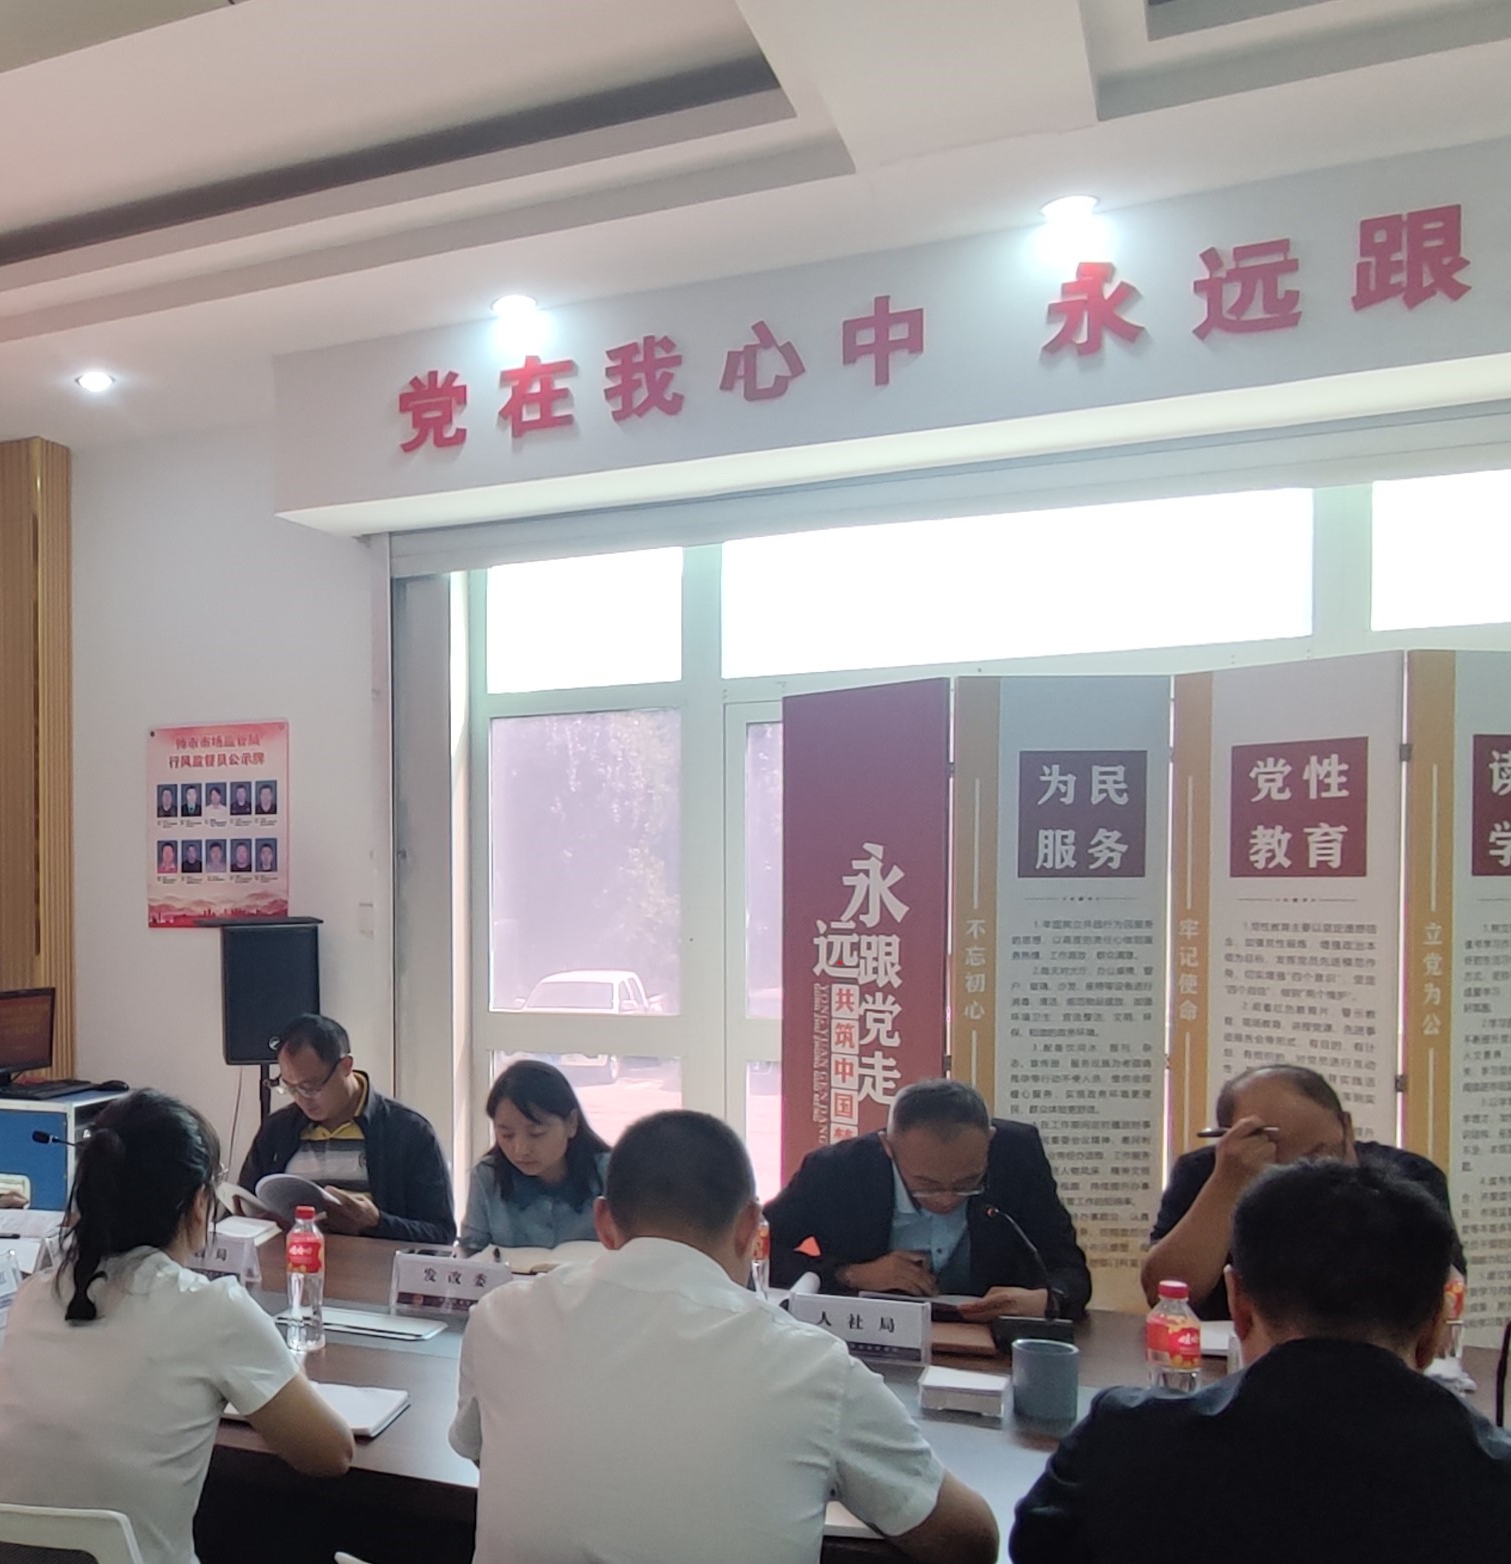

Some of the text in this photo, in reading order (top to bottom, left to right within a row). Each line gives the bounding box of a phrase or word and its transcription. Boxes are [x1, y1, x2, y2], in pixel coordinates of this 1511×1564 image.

[398, 203, 1472, 453] 党在我心中 永远跟
[1037, 764, 1130, 806] 为民
[1249, 753, 1350, 803] 党性
[1035, 828, 1130, 870] 服务
[1249, 822, 1350, 870] 教育
[964, 918, 986, 1021] 不忘初心
[1178, 917, 1200, 1022] 牢记使命
[1421, 921, 1444, 1036] 立党为公
[422, 1267, 489, 1289] 发改委
[816, 1310, 897, 1334] 人社局
